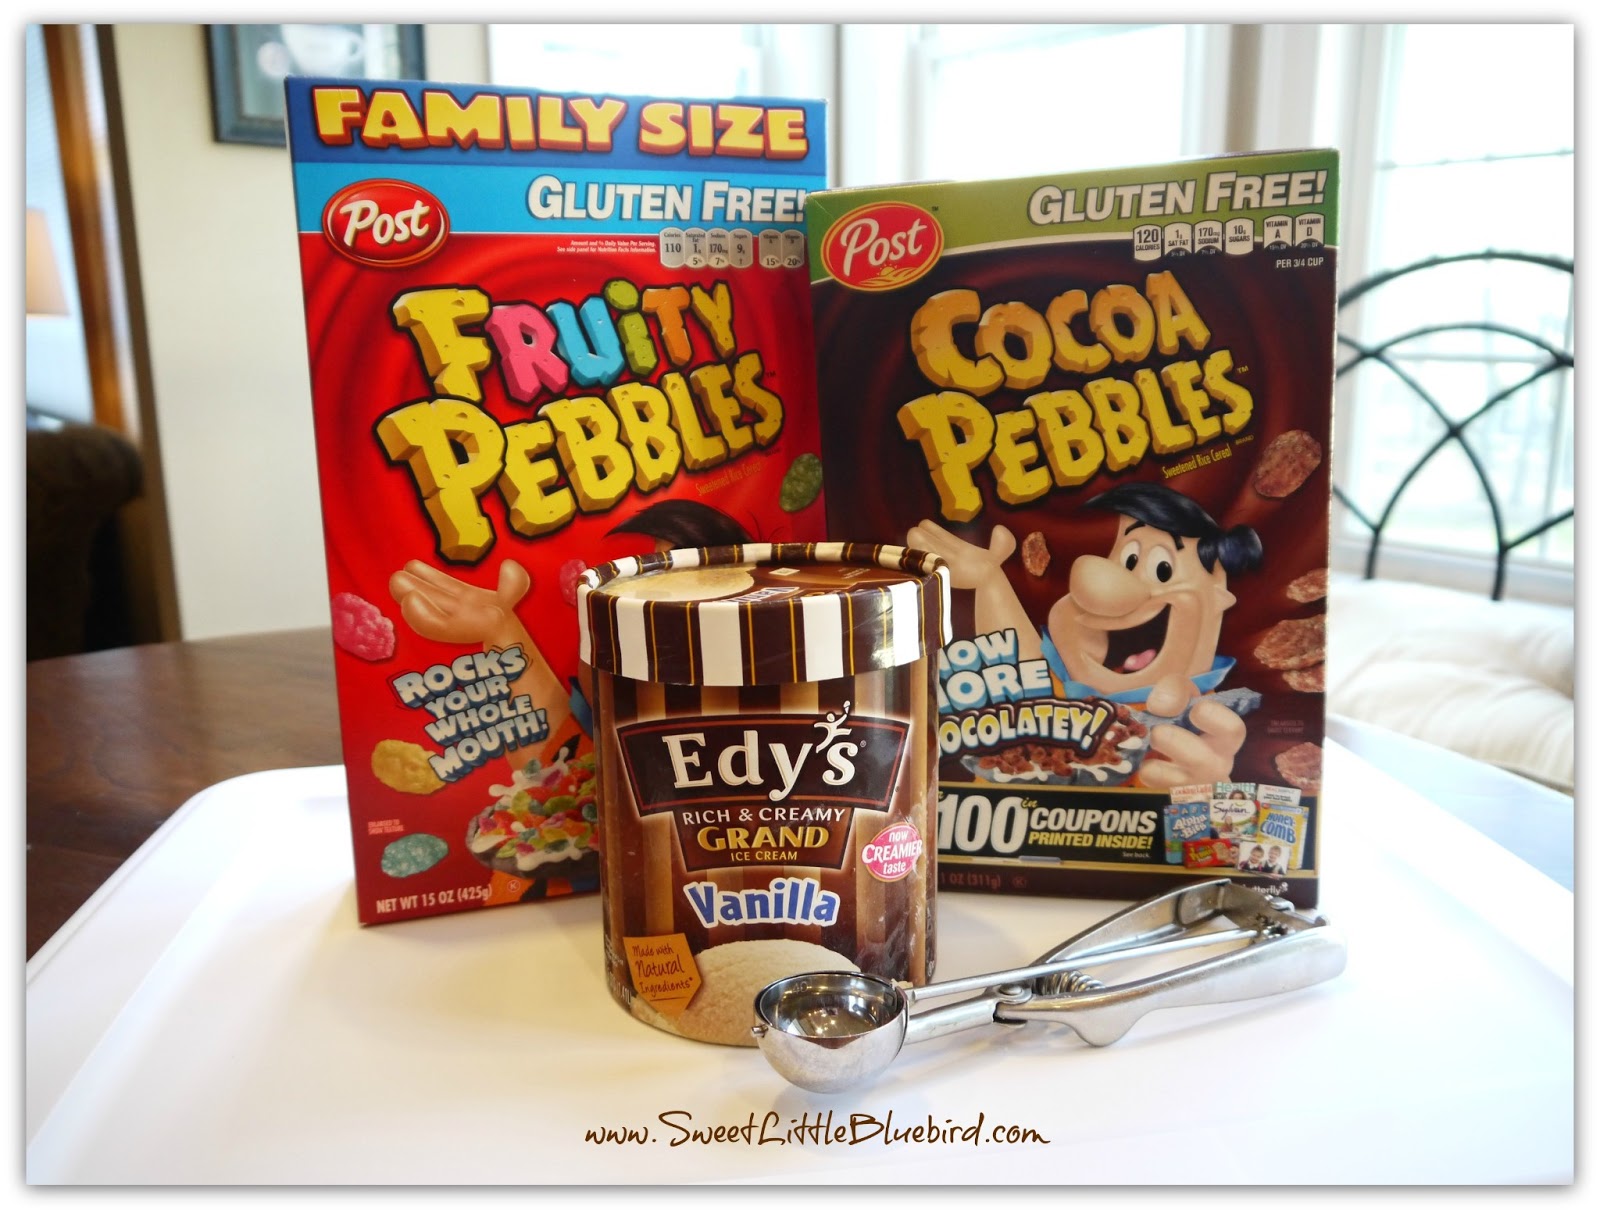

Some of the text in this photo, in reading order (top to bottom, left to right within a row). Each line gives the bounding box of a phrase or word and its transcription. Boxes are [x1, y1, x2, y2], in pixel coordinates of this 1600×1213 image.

[311, 87, 809, 158] FAMILY SIZE
[527, 175, 805, 223] GLUTEN FREE!
[1028, 169, 1328, 225] GLUTEN FREE!
[338, 198, 430, 249] Post
[1136, 228, 1159, 243] 120
[1266, 220, 1288, 239] VITAMIN A
[1298, 218, 1321, 237] VITAMIN D
[665, 243, 681, 253] 110
[842, 215, 929, 275] Post
[1198, 237, 1219, 245] SODIUM
[1276, 257, 1324, 268] PER 3/4 CUP
[910, 270, 1211, 397] COCOA
[897, 350, 1254, 522] PEBBLES
[375, 352, 784, 564] PEBBLES
[1162, 443, 1233, 479] Sweetened Rice Cereal
[695, 471, 730, 496] Sweetened
[392, 646, 526, 708] ROCKS
[939, 659, 1053, 712] ORE
[424, 675, 512, 719] YOUR
[424, 694, 533, 746] WHOLE
[939, 704, 1108, 757] OCOLATEY!
[427, 708, 549, 782] MOUTH!
[662, 727, 859, 802] Edy's
[683, 808, 846, 825] RICH & CREAMY
[1021, 797, 1038, 808] in
[1030, 807, 1158, 834] COUPONS
[1172, 814, 1207, 831] Alpha
[1213, 801, 1251, 820] Sylvan
[696, 826, 830, 851] GRAND
[889, 831, 908, 842] now
[1028, 832, 1153, 849] PRINTED INSIDE!
[1180, 822, 1207, 839] Bits
[1260, 820, 1297, 845] COMB
[731, 850, 798, 862] ICE CREAM
[862, 839, 922, 863] CREAMIER
[883, 861, 906, 874] taste
[949, 873, 965, 886] OZ
[967, 872, 1001, 889] (311g)
[376, 884, 493, 914] NET WT 15 OZ (425g)
[684, 877, 840, 928] Vanilla
[632, 943, 674, 957] Made with
[635, 954, 685, 978] Natural
